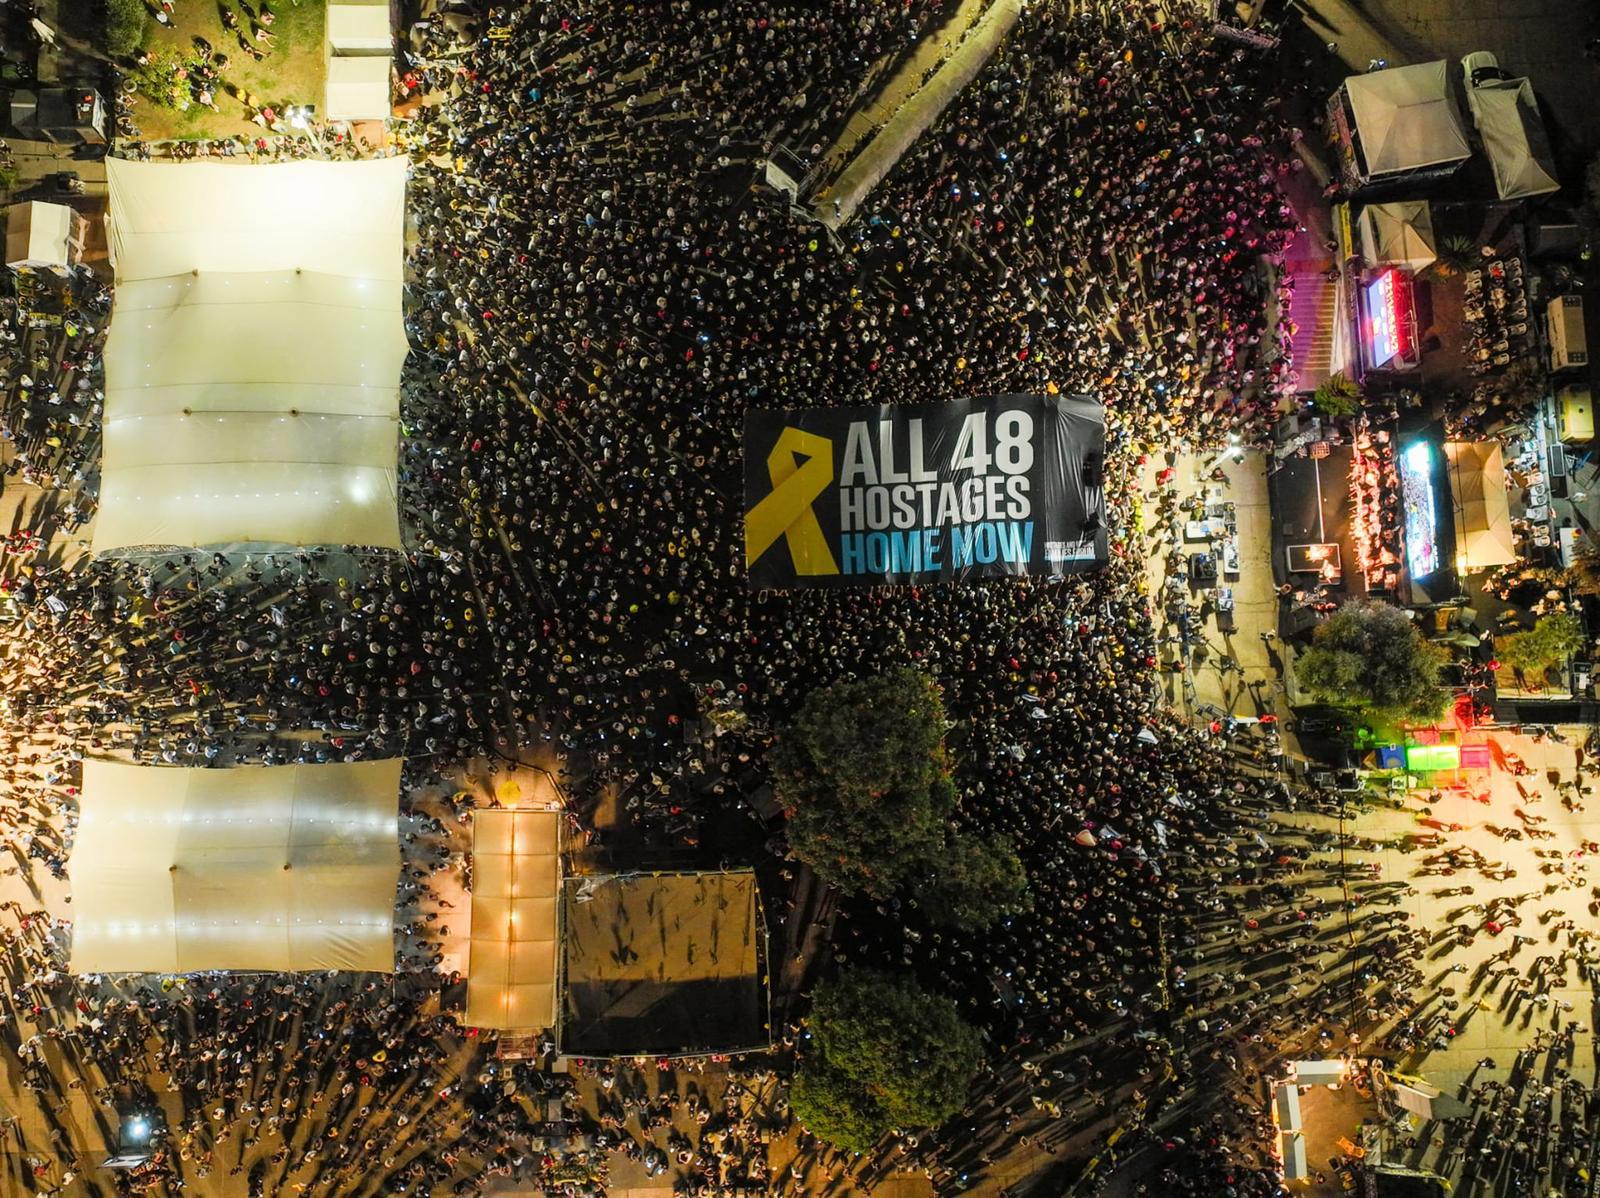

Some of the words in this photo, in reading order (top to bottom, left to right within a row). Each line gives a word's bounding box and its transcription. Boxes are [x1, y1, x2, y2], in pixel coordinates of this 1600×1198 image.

[840, 418, 937, 486] ALL
[951, 410, 1033, 476] 48
[840, 475, 1031, 531] HOSTAGES
[842, 529, 942, 575] HOME
[951, 521, 1034, 569] NOW
